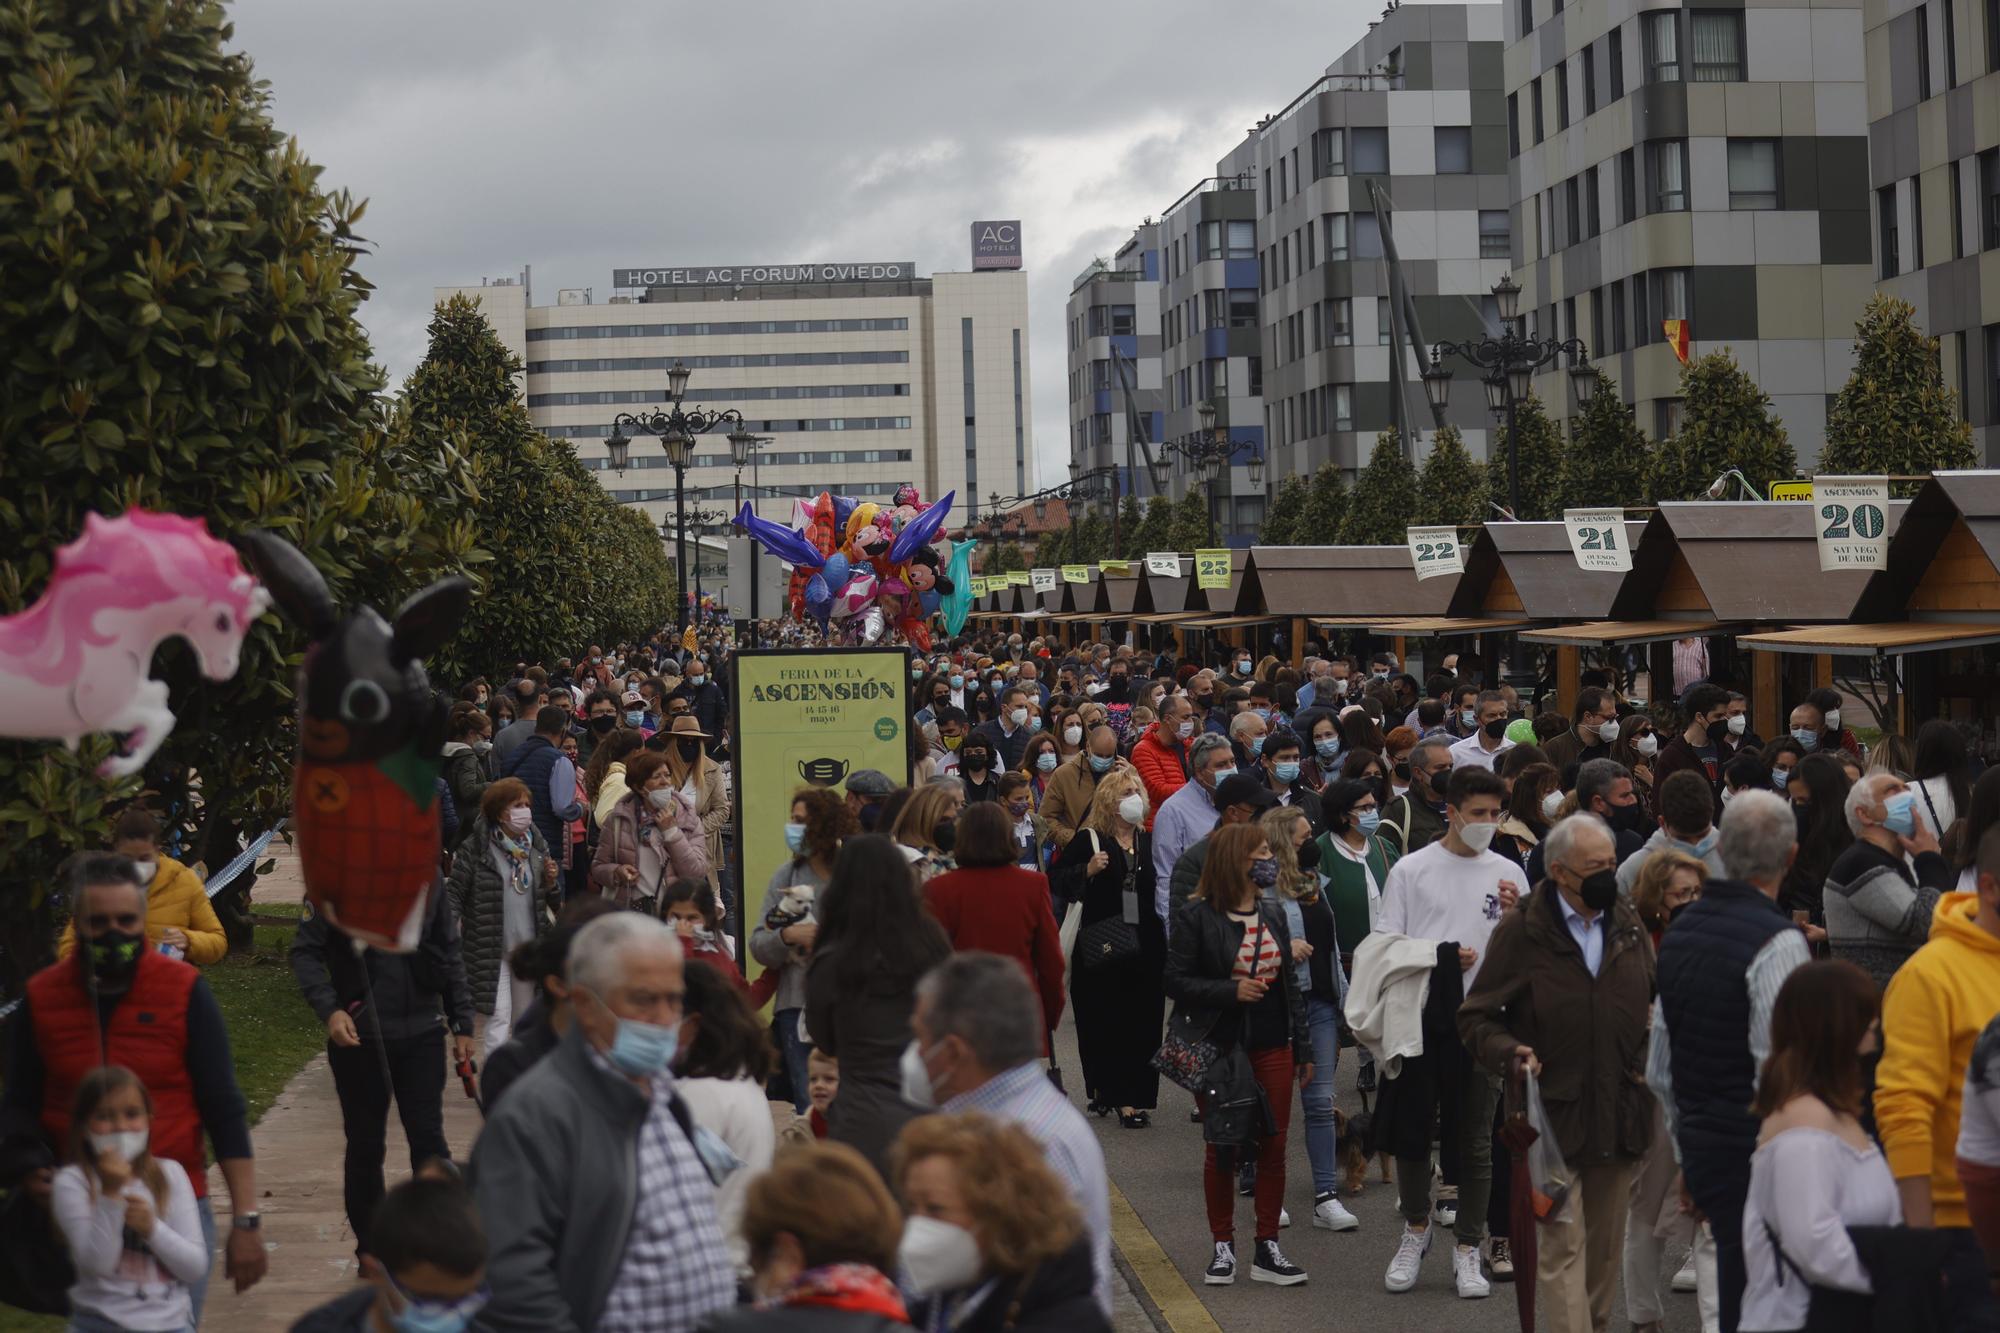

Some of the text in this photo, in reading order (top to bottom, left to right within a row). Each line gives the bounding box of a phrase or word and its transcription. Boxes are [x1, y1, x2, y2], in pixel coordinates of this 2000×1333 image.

[980, 225, 1015, 243] AC
[628, 265, 901, 285] HOTEL AC FORUM OVIEDO
[1824, 488, 1879, 497] ASCENSIÓN
[1822, 504, 1884, 539] 20
[1578, 527, 1617, 550] 21
[1416, 542, 1455, 561] 22
[1833, 546, 1878, 554] SAT VEGA
[1854, 555, 1876, 563] ARIO
[1035, 575, 1053, 584] 27
[780, 668, 863, 680] FERIA DE LA
[749, 677, 895, 702] ASCENSIÓN
[810, 716, 836, 725] mayo
